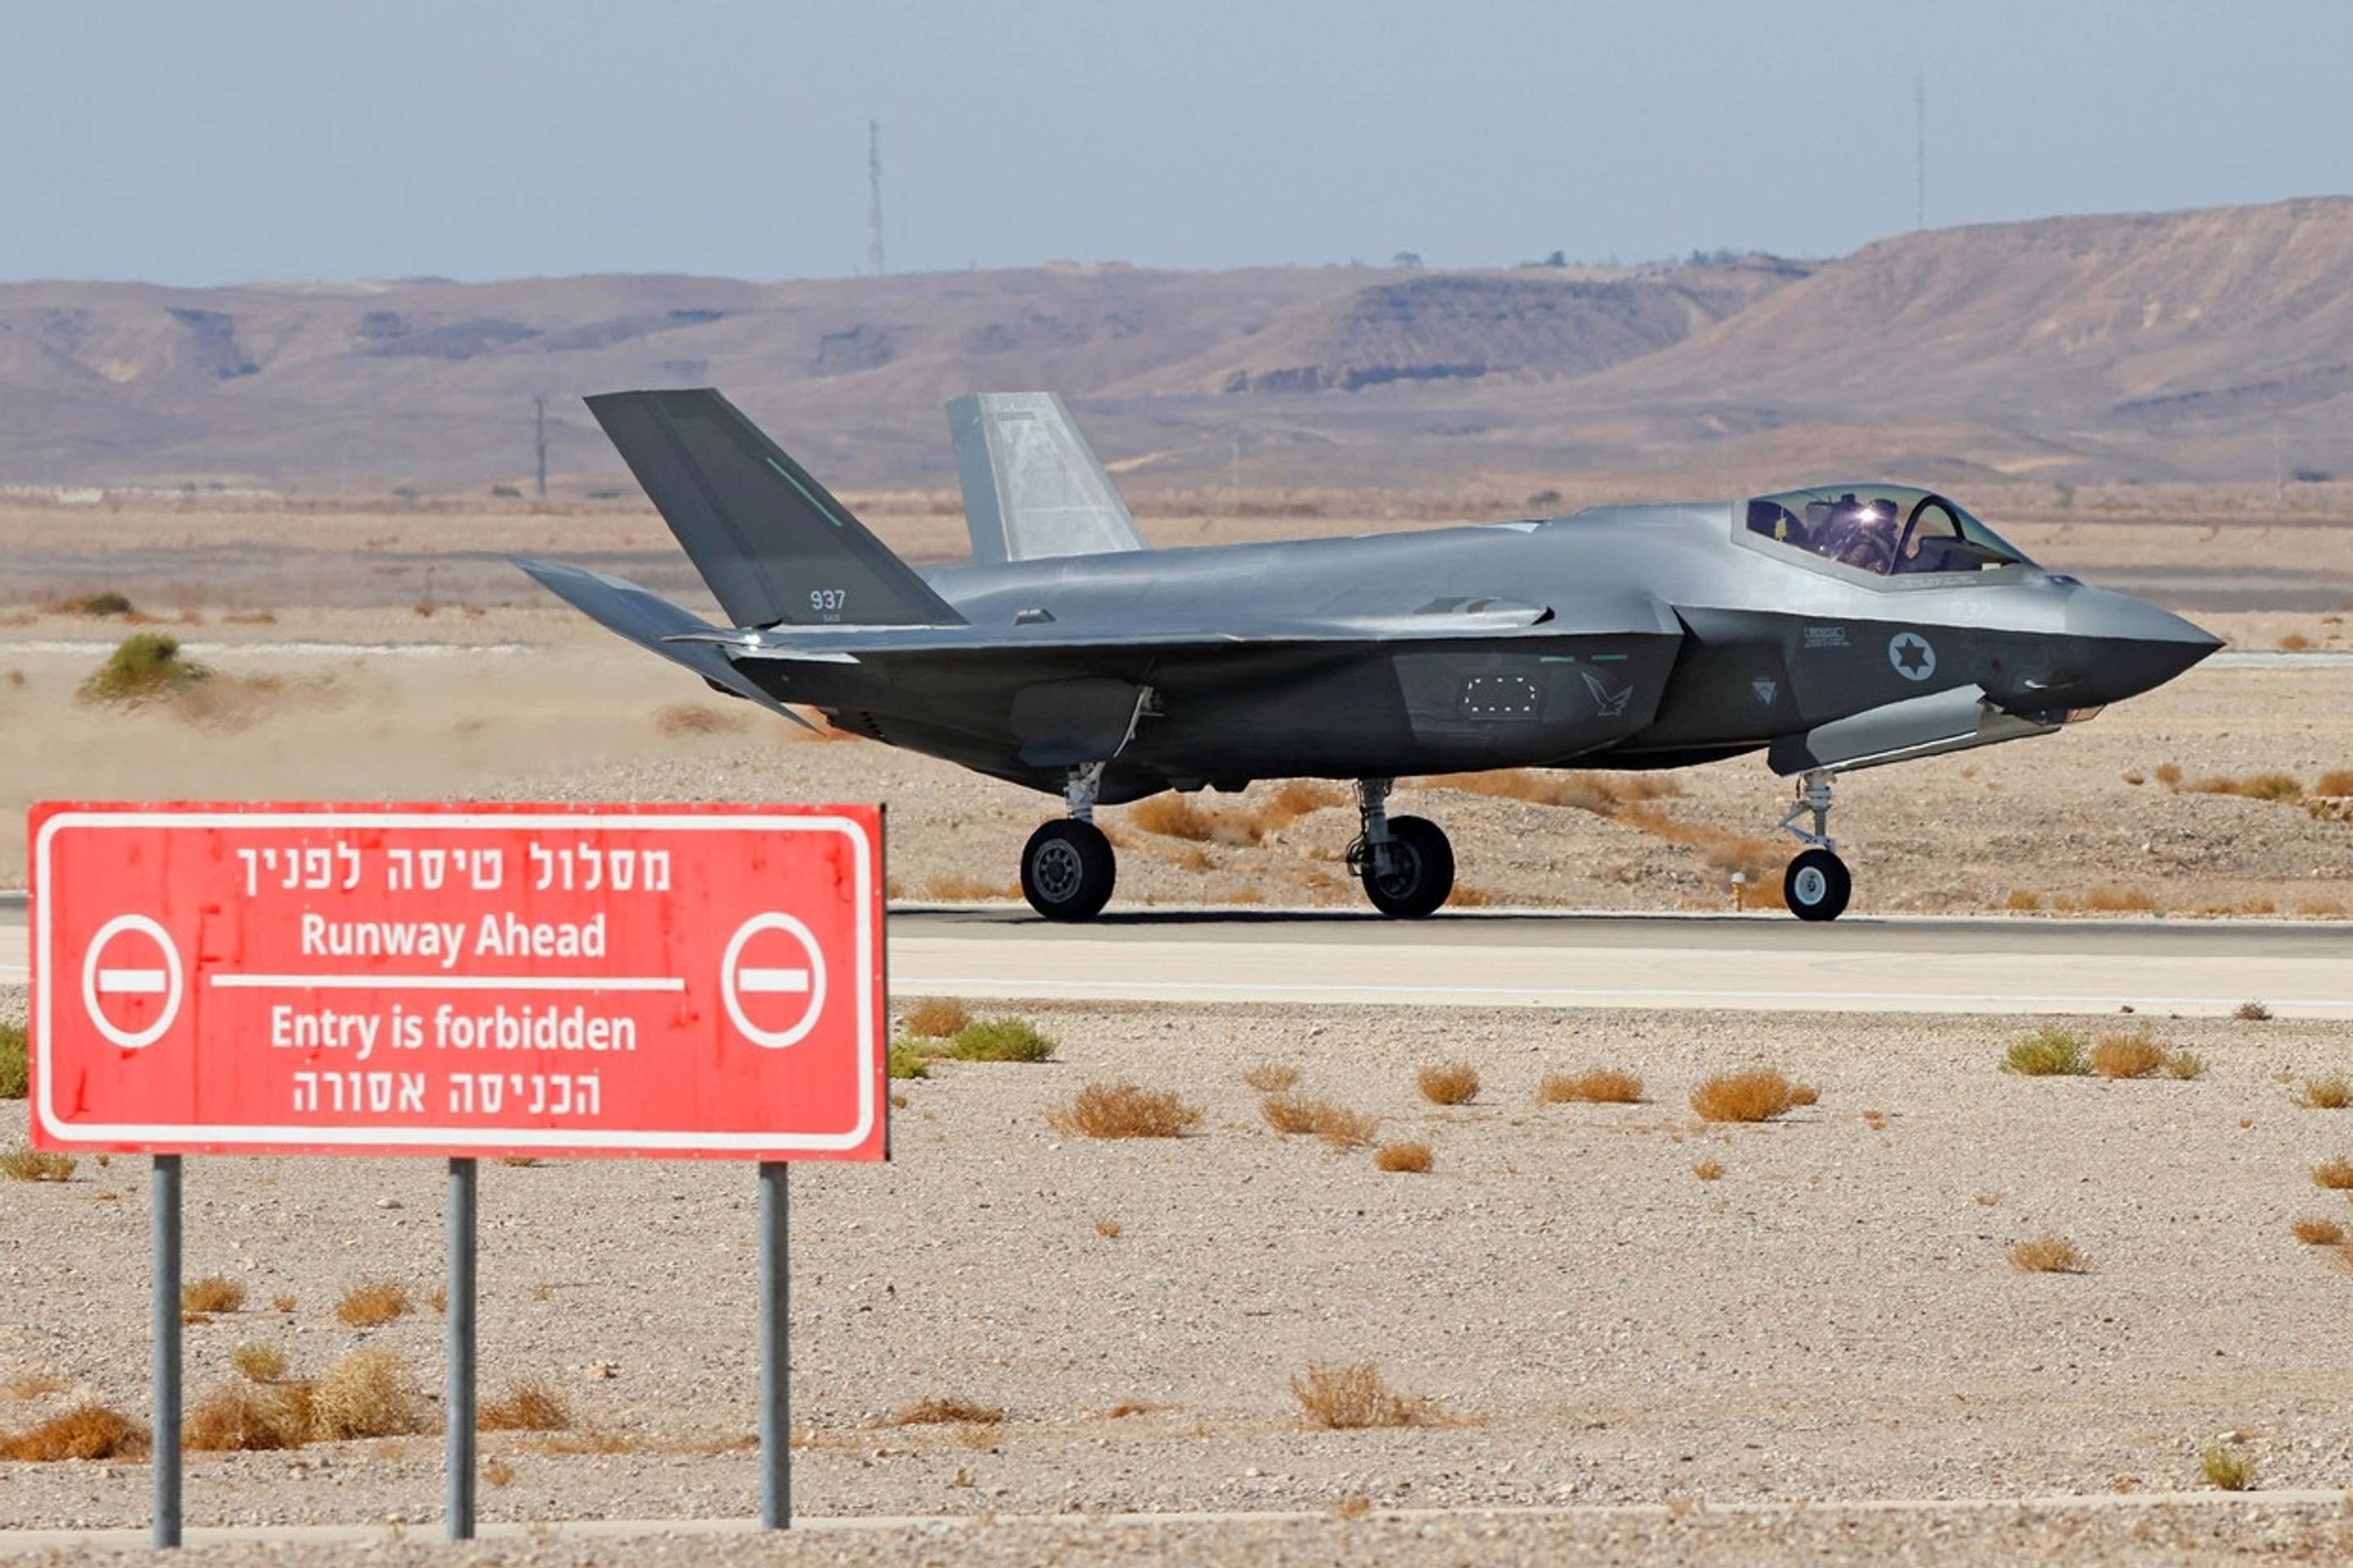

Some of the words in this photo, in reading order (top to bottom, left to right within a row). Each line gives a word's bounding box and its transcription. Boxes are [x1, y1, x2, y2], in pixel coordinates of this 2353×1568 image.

[810, 590, 846, 609] 937
[237, 841, 360, 897] לפניך
[388, 849, 502, 890] טיסה
[530, 842, 671, 891] מסלול
[301, 913, 466, 969] Runway
[475, 912, 605, 957] Ahead
[272, 1005, 381, 1060] Entry
[392, 1004, 424, 1049] is
[434, 1004, 635, 1051] forbidden
[294, 1071, 425, 1112] אסורה
[449, 1073, 600, 1115] הכניסה
